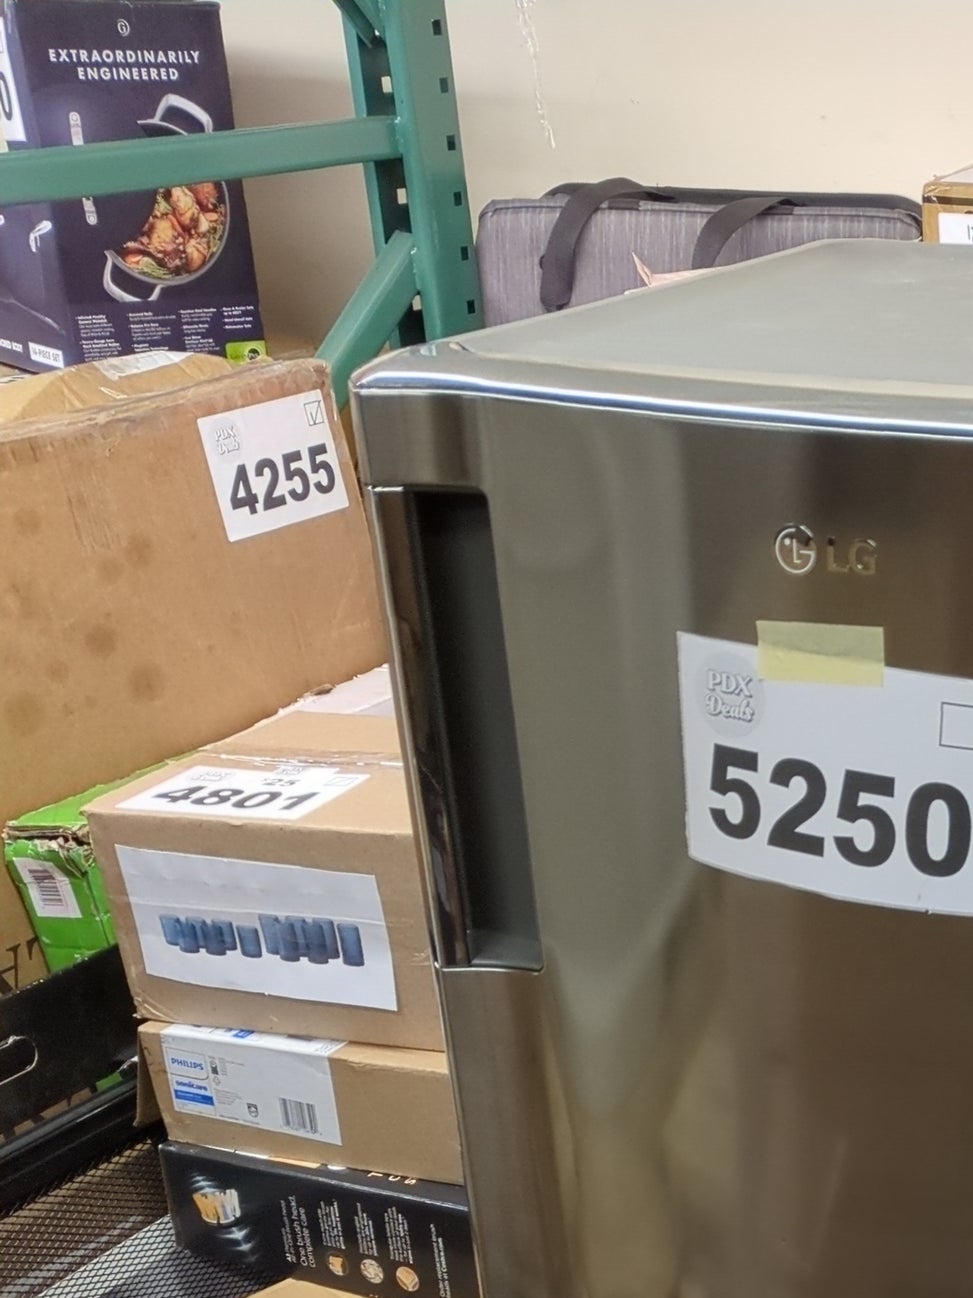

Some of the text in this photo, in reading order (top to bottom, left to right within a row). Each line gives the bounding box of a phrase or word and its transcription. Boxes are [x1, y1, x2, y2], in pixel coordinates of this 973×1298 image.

[48, 48, 200, 64] EXTRAORDINARILY
[77, 67, 180, 81] ENGINEERED
[215, 425, 237, 442] PDX
[230, 442, 336, 515] 4255
[826, 537, 877, 575] LG
[706, 669, 754, 698] PDX
[704, 693, 756, 723] Deals
[152, 785, 321, 811] 4801
[708, 742, 972, 878] 5250
[171, 1057, 204, 1070] PHILIPS
[293, 1221, 304, 1246] brush
[299, 1207, 316, 1268] complete care
[299, 1247, 308, 1267] One
